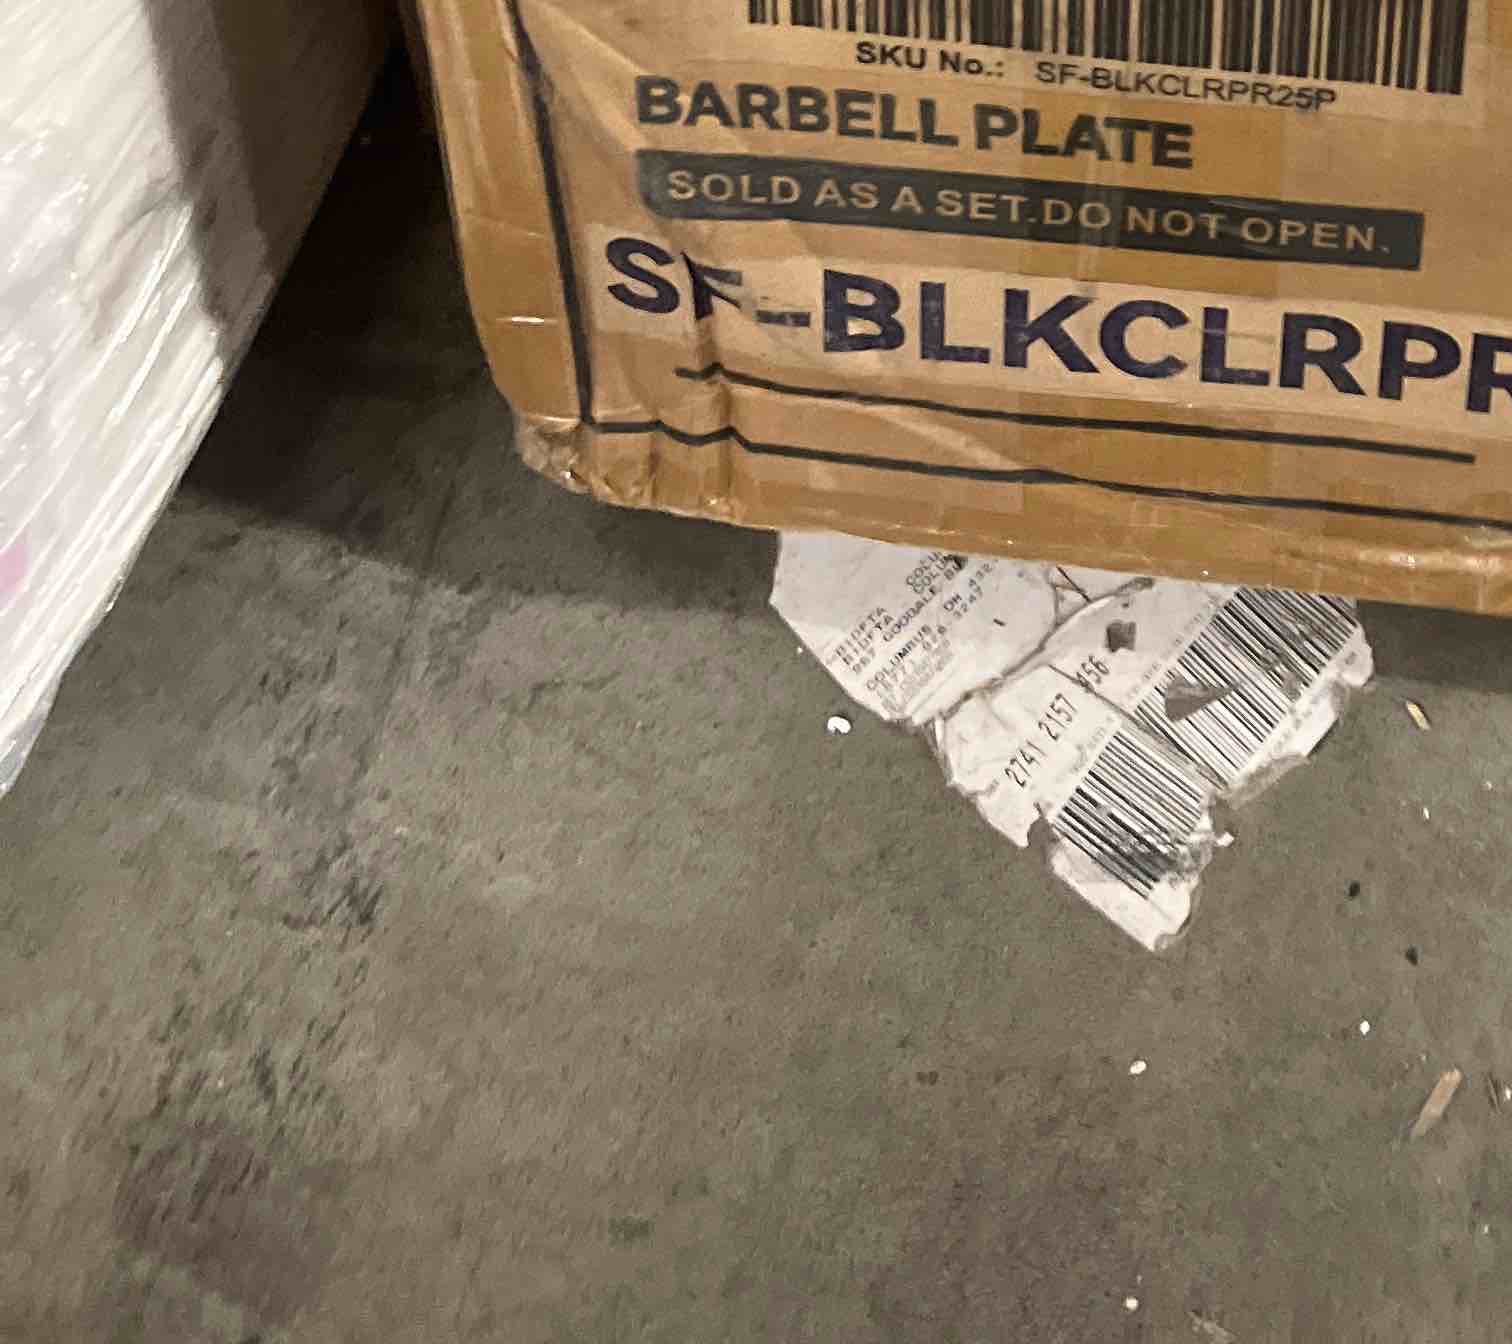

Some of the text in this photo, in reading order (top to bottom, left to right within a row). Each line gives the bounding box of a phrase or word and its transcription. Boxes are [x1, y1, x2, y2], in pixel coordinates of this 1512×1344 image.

[854, 41, 927, 70] SKU
[1035, 62, 1336, 112] SF-BLKCLRPR25P
[635, 76, 1195, 169] BARBELL PLATE
[666, 169, 800, 206] SOLD
[814, 177, 882, 211] AS
[892, 184, 926, 214] A
[1124, 202, 1229, 237] NOT
[1240, 215, 1392, 254] OPEN.
